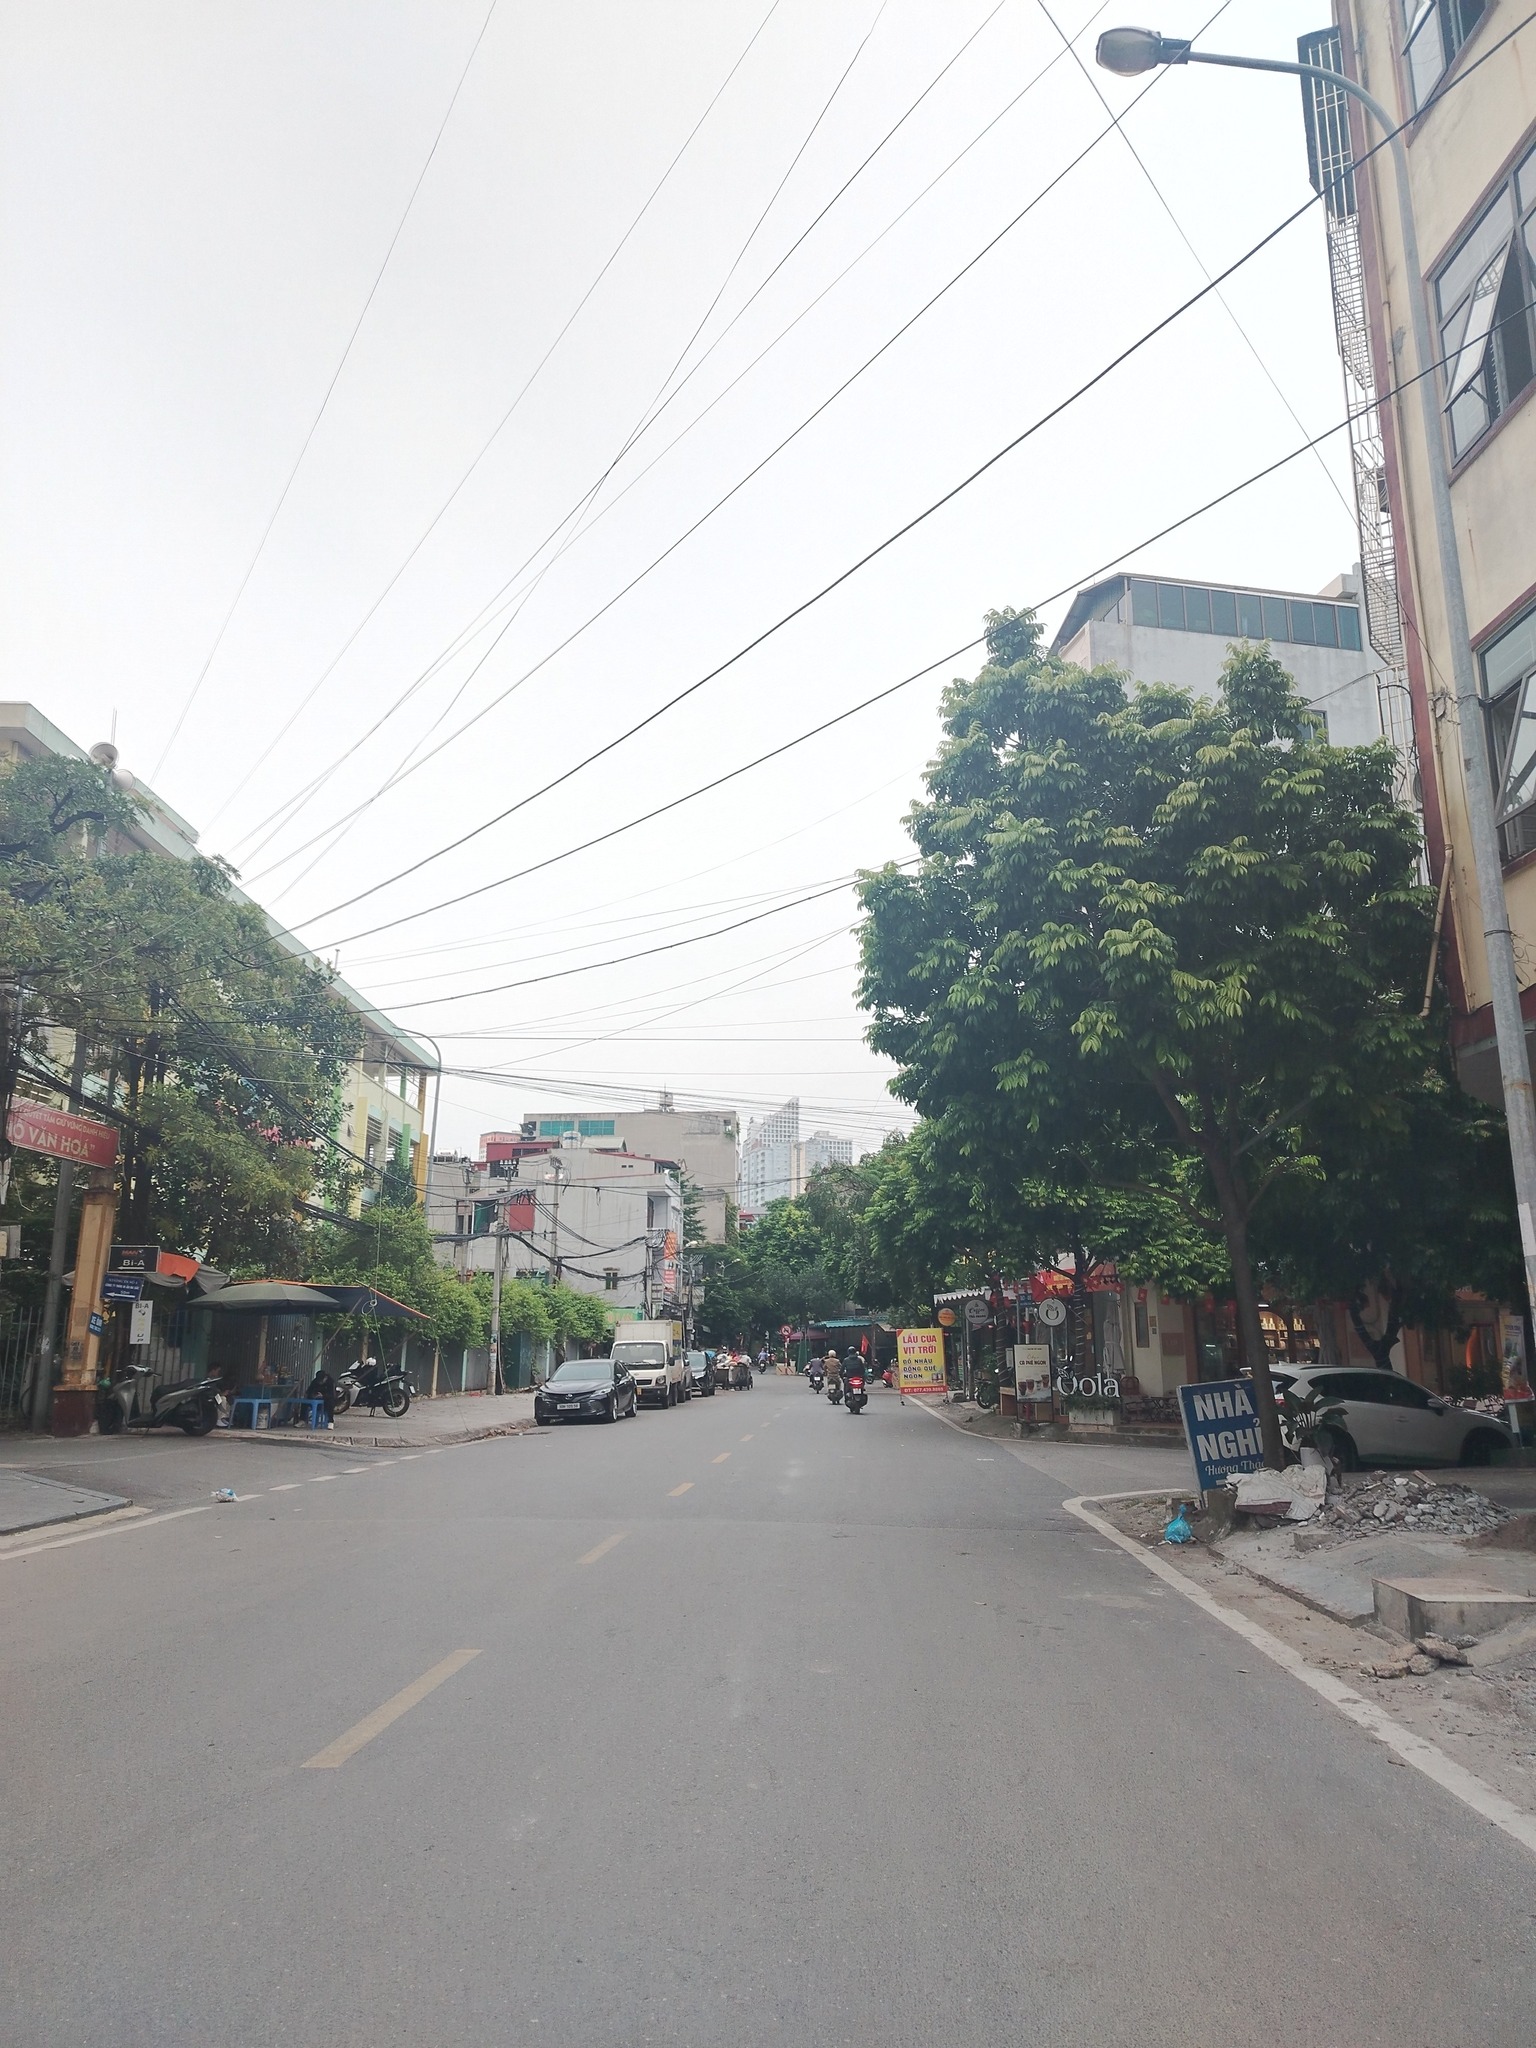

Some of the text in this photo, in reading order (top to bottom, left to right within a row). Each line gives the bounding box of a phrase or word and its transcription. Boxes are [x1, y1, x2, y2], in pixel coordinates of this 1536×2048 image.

[29, 1126, 57, 1149] VĂN
[920, 1335, 937, 1343] CUA
[1193, 1384, 1254, 1421] NHÀ
[1196, 1417, 1264, 1462] NGHỈ
[1205, 1464, 1239, 1476] Hương
